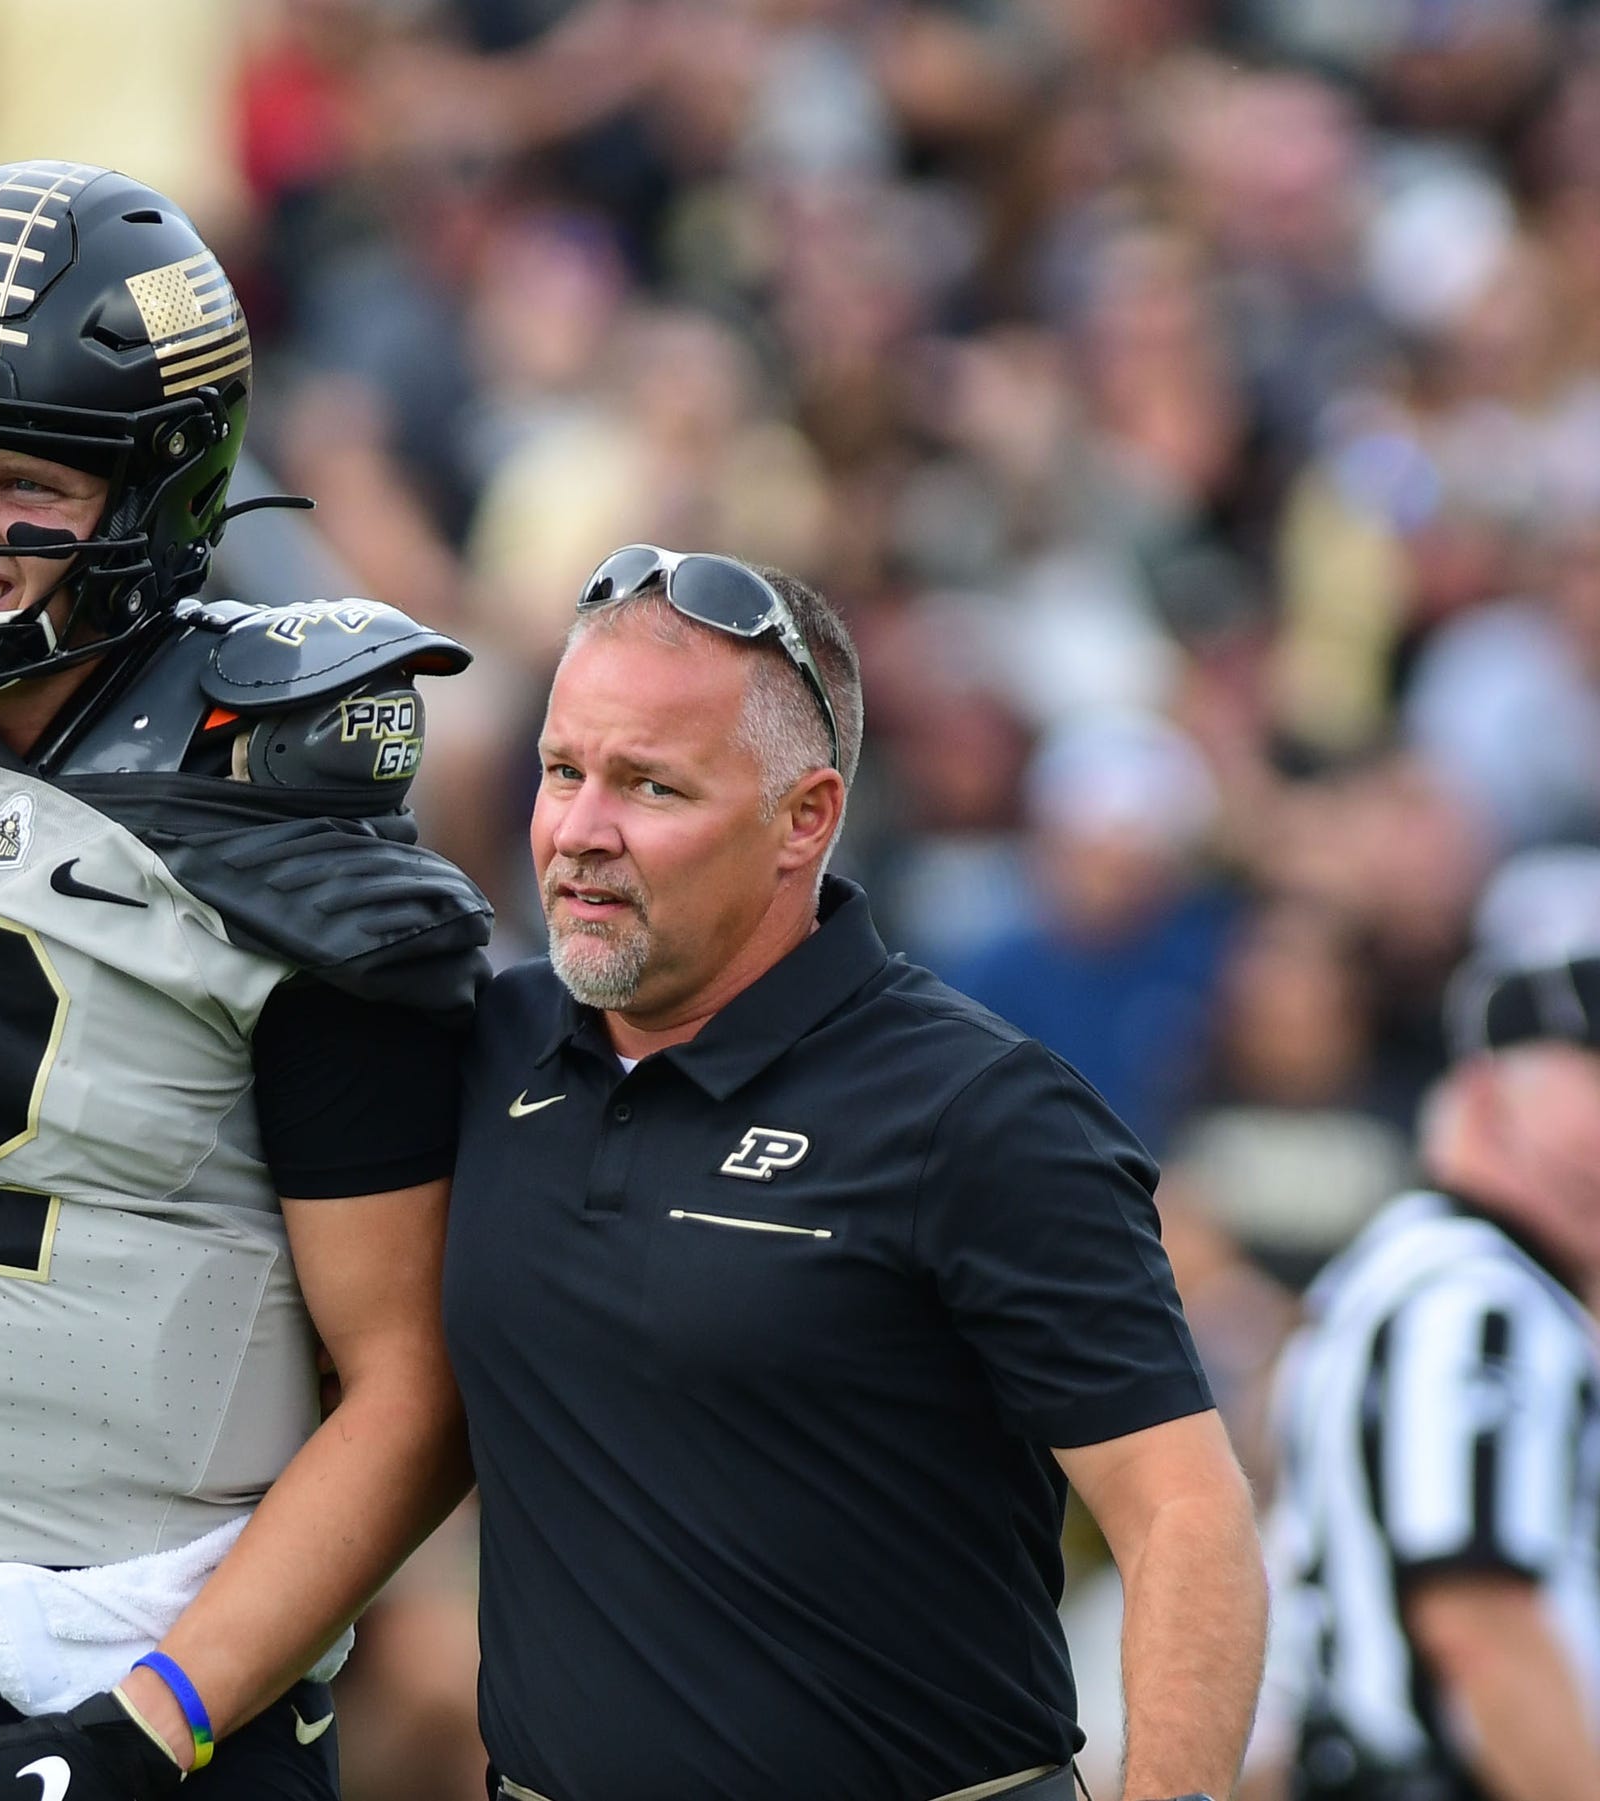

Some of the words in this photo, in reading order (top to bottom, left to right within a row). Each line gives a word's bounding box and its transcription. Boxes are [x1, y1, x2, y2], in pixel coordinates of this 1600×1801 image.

[341, 696, 415, 742] PRO
[373, 736, 424, 780] GE
[720, 1126, 810, 1178] P
